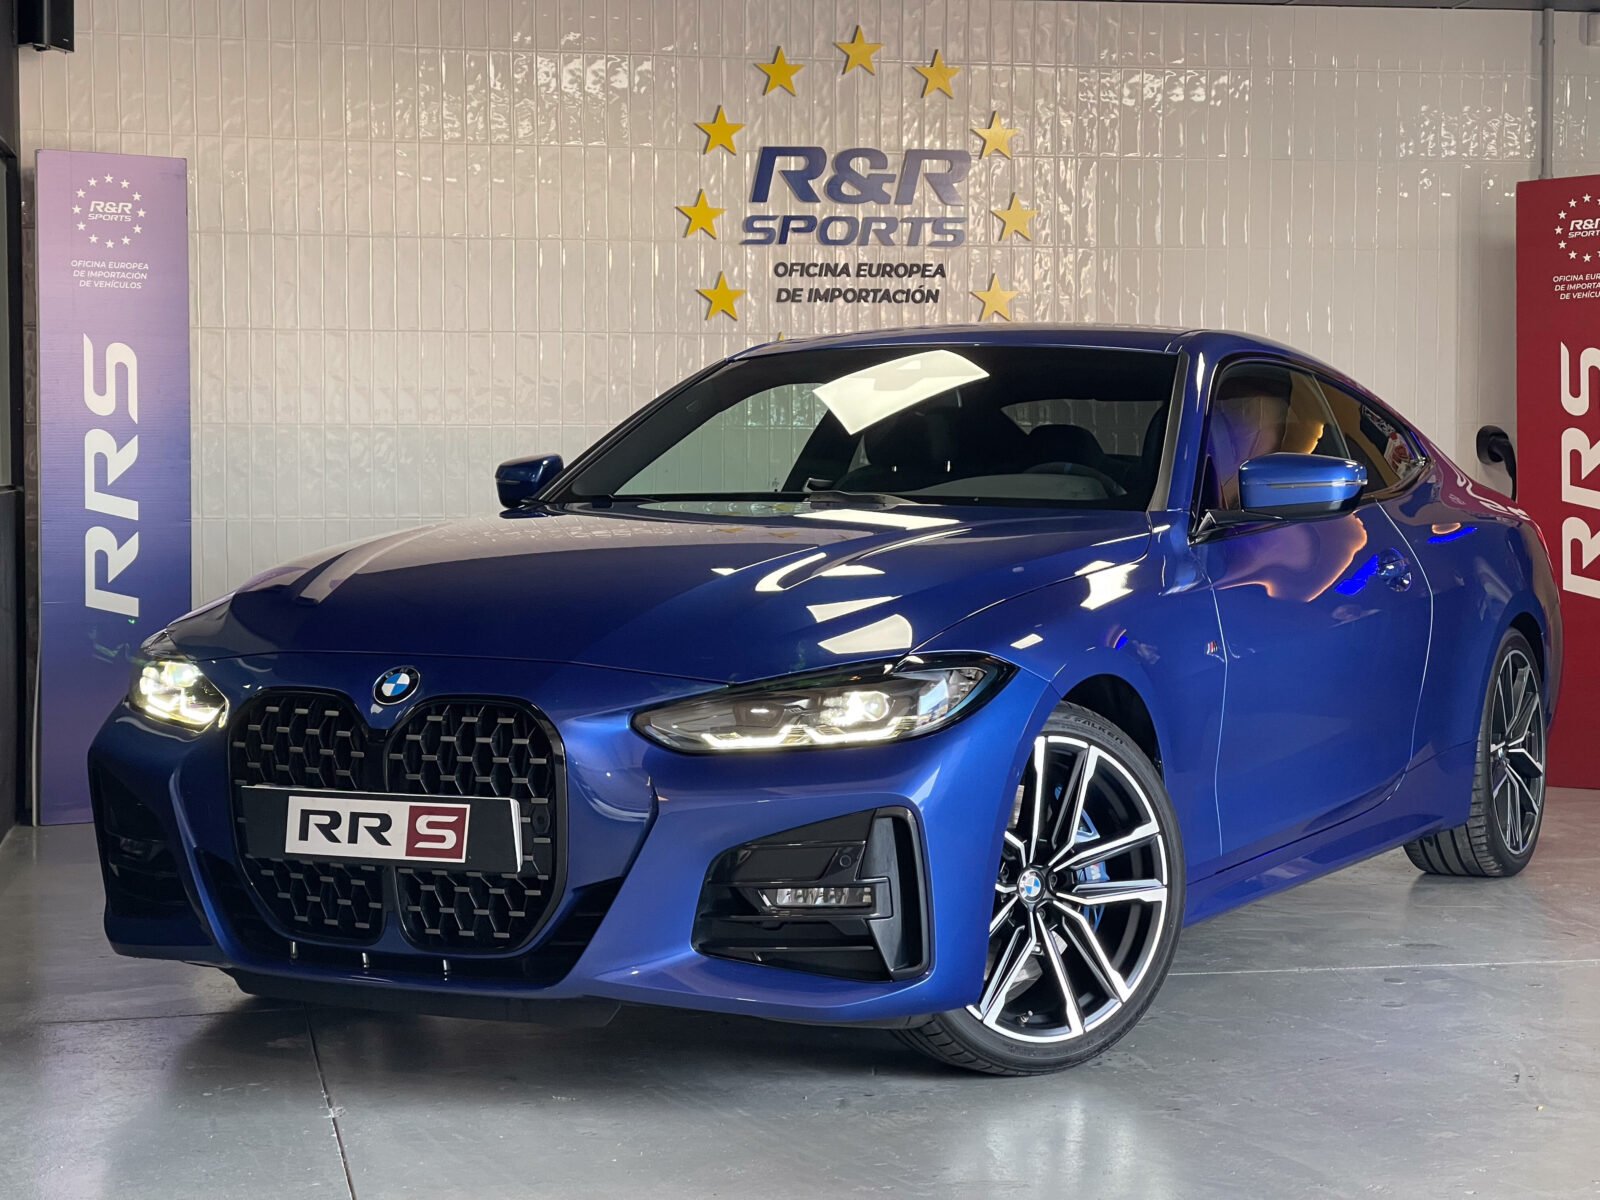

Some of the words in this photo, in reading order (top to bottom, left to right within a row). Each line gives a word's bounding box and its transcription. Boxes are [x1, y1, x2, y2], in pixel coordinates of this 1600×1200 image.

[750, 146, 972, 206] R&R
[90, 201, 132, 214] R&R
[88, 213, 132, 221] SPORTS
[740, 214, 968, 247] SPORTS
[71, 260, 106, 268] OFICINA
[108, 261, 149, 270] EUROPEA
[773, 261, 850, 278] OFICINA
[855, 262, 946, 279] EUROPEA
[79, 280, 92, 288] DE
[93, 279, 142, 289] VEHÍCULOS
[1554, 284, 1566, 292] DE
[776, 287, 803, 303] DE
[807, 284, 940, 304] IMPORTACIÓN
[1559, 292, 1571, 300] DE
[83, 333, 139, 618] RRS
